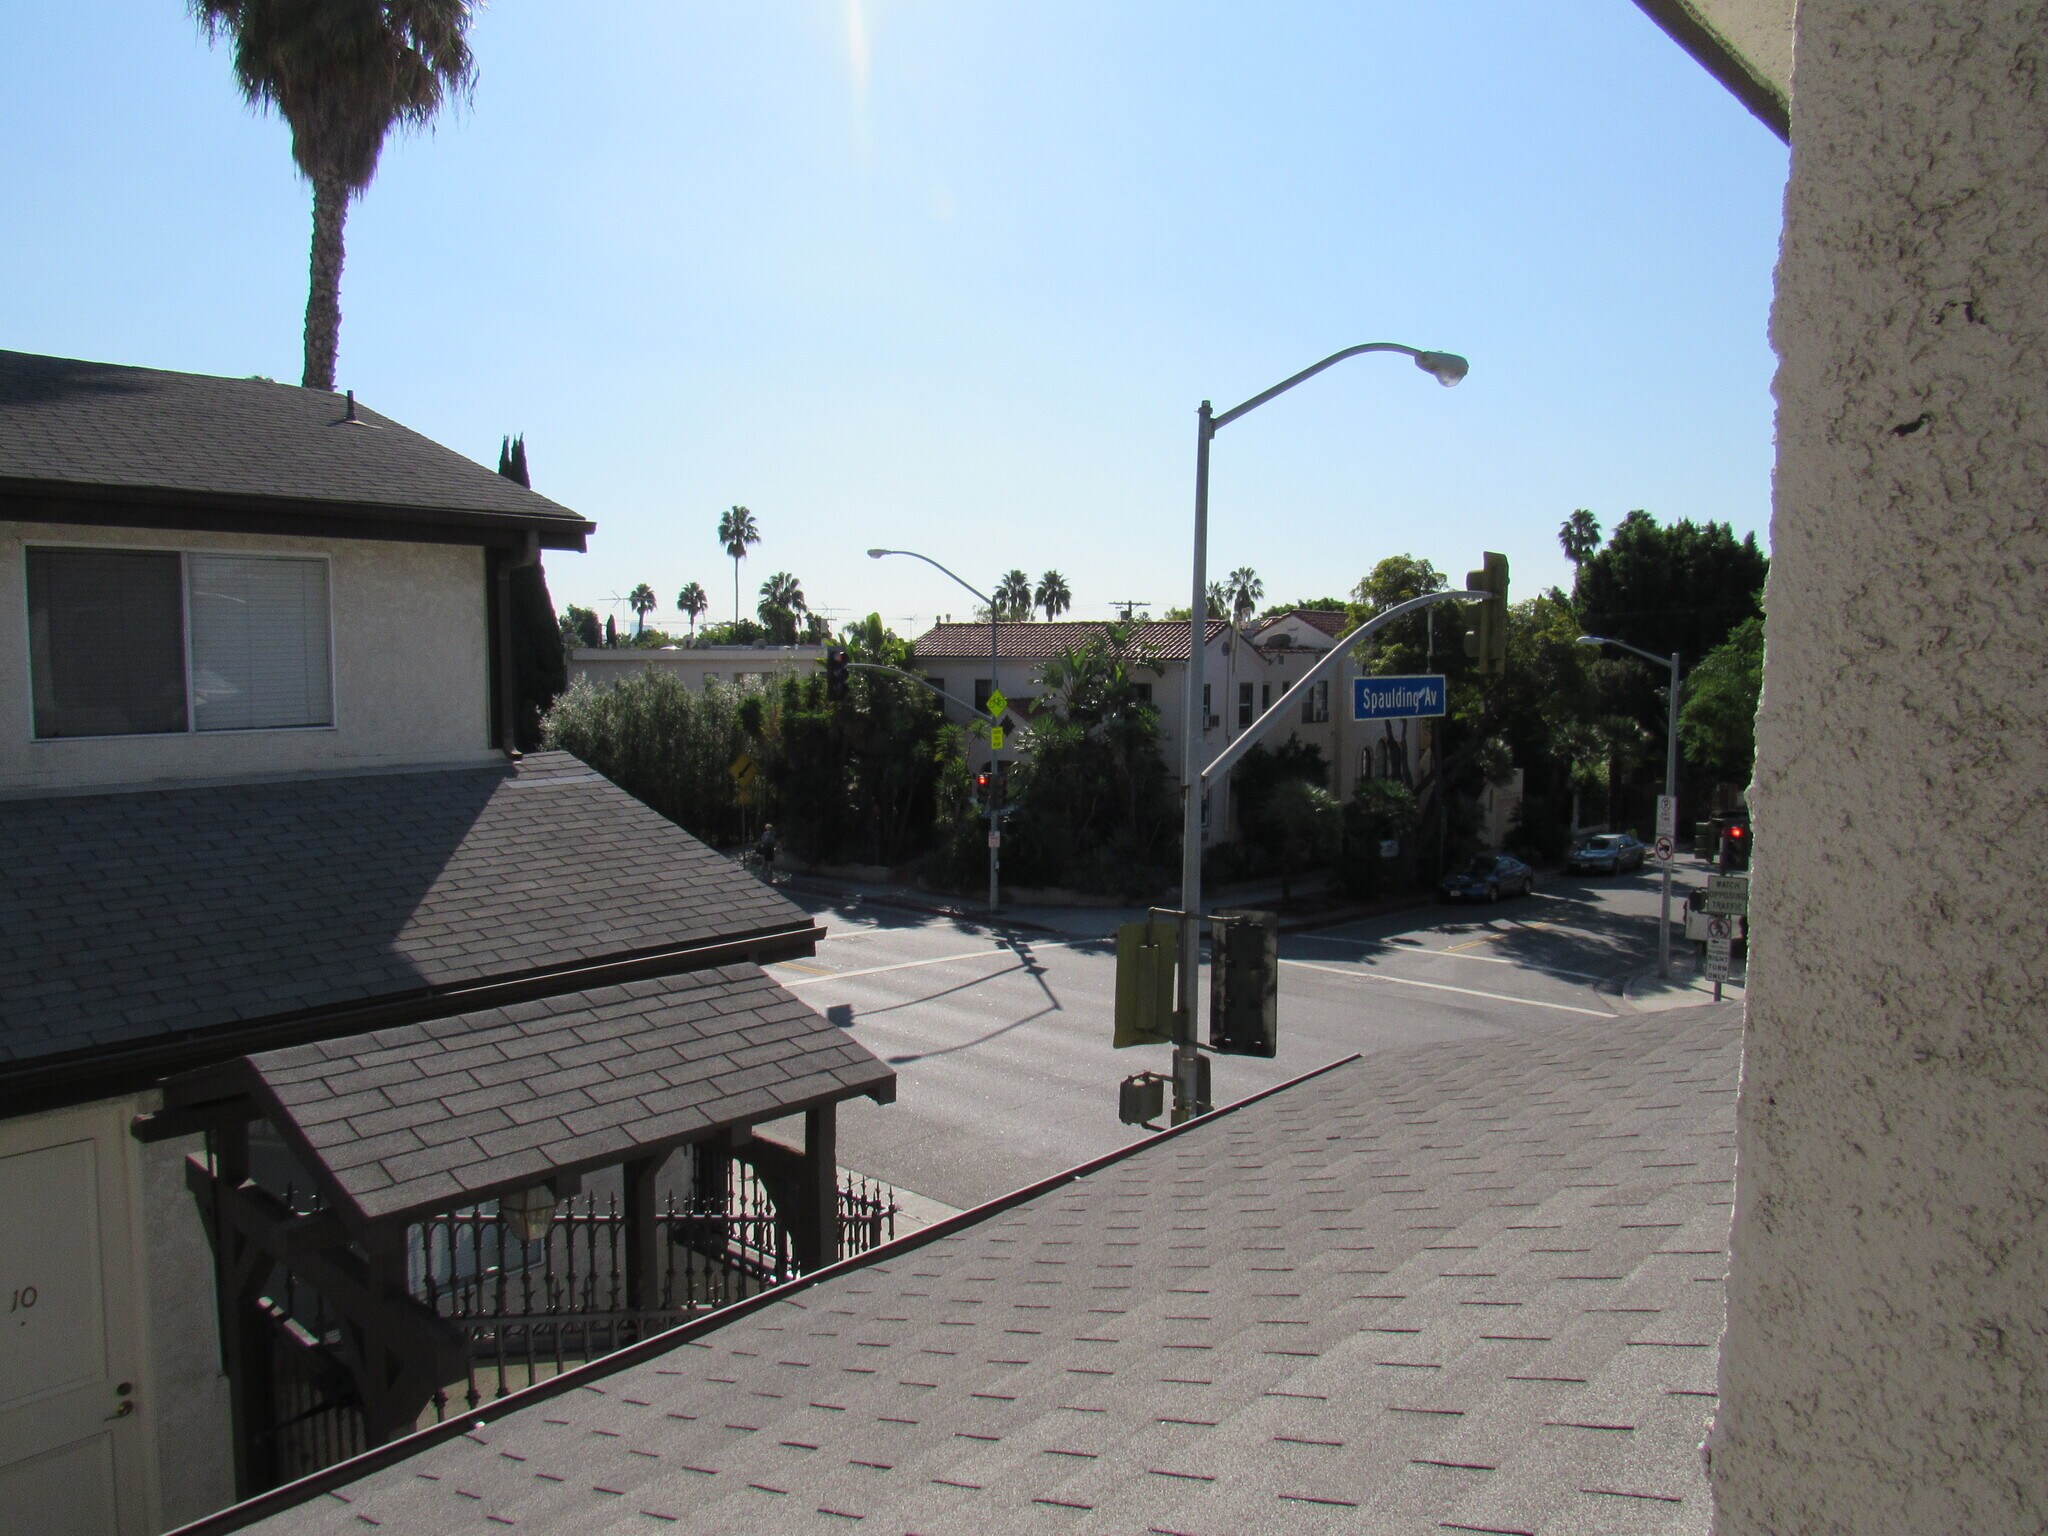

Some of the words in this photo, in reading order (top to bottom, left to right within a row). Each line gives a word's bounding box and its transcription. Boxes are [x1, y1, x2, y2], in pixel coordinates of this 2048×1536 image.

[1363, 687, 1420, 714] Spaulding
[1424, 686, 1437, 706] Av
[1712, 901, 1743, 911] TRAFFIC
[1707, 954, 1729, 964] RIGHT
[1707, 963, 1727, 972] TURN
[1707, 972, 1727, 981] ONLY
[10, 1286, 38, 1314] 10
